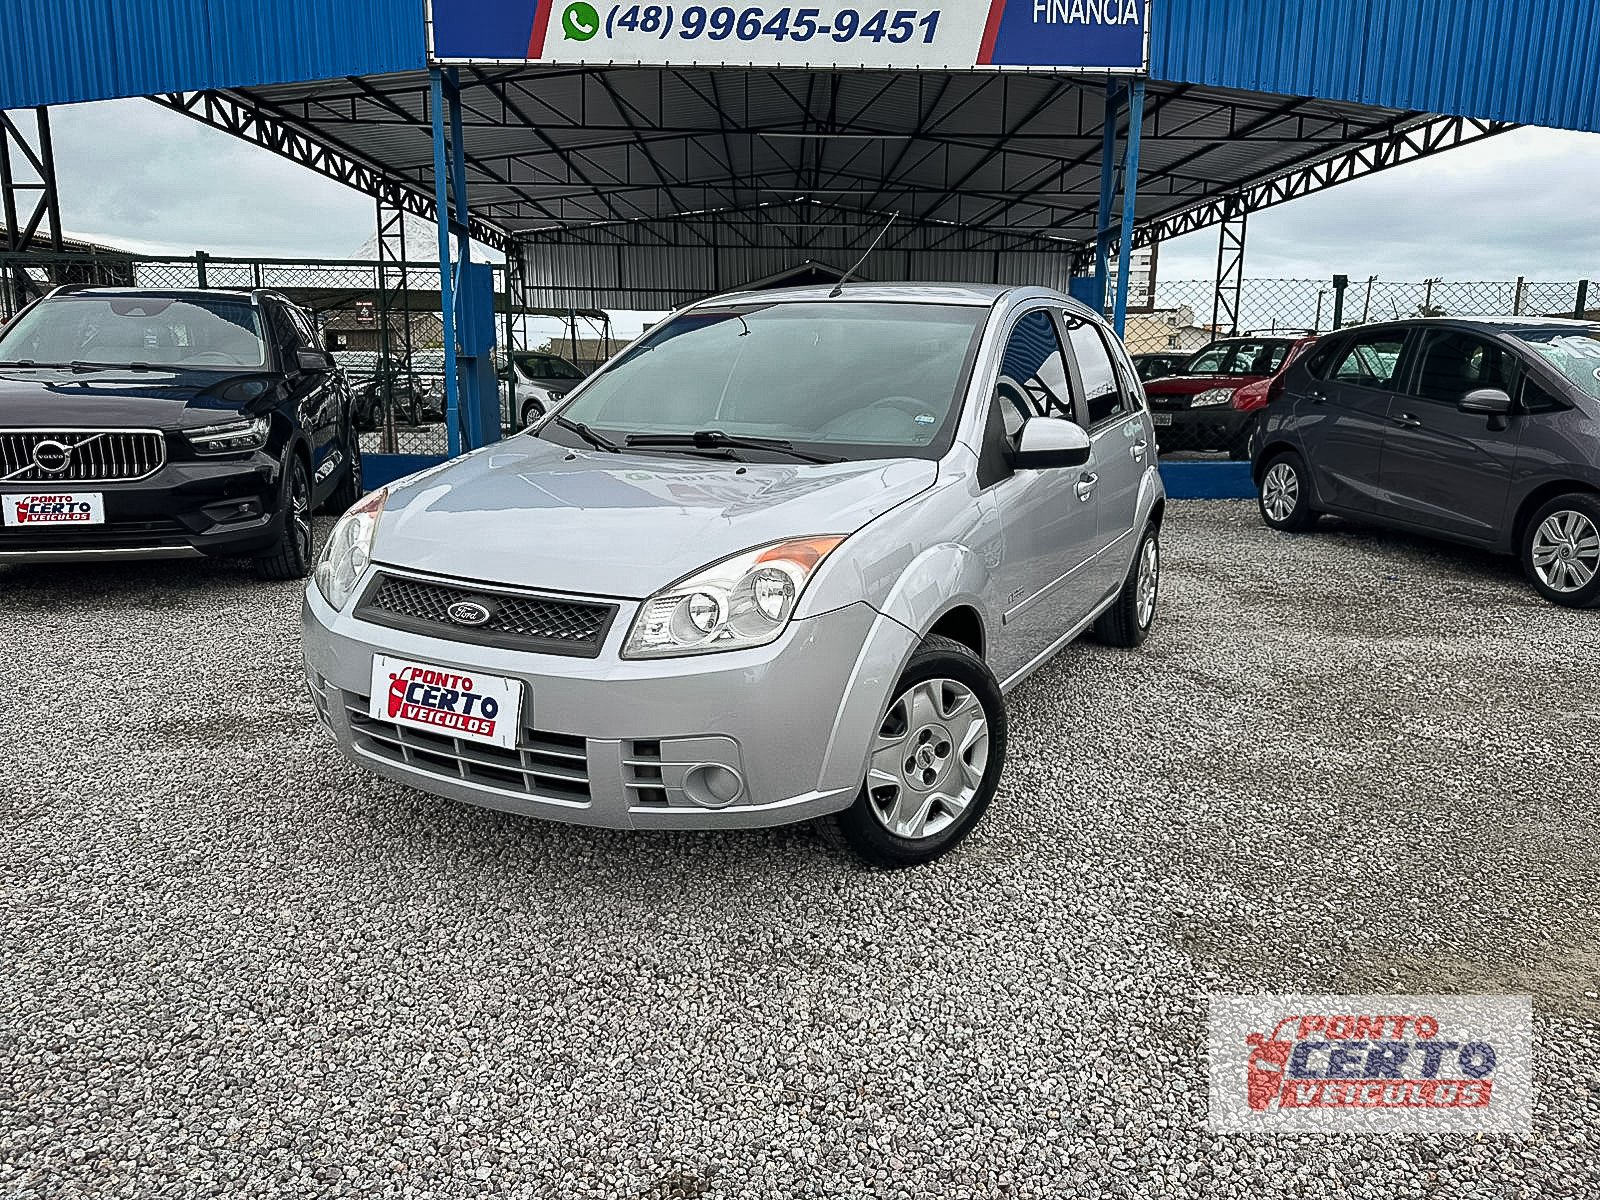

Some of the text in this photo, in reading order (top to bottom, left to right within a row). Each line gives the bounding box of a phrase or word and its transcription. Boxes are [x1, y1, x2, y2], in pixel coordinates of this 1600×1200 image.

[605, 4, 940, 44] (48) 99645-9451
[29, 502, 91, 514] CERTO
[454, 605, 478, 619] Ford
[410, 667, 473, 691] PONTO
[405, 682, 499, 719] CERTO
